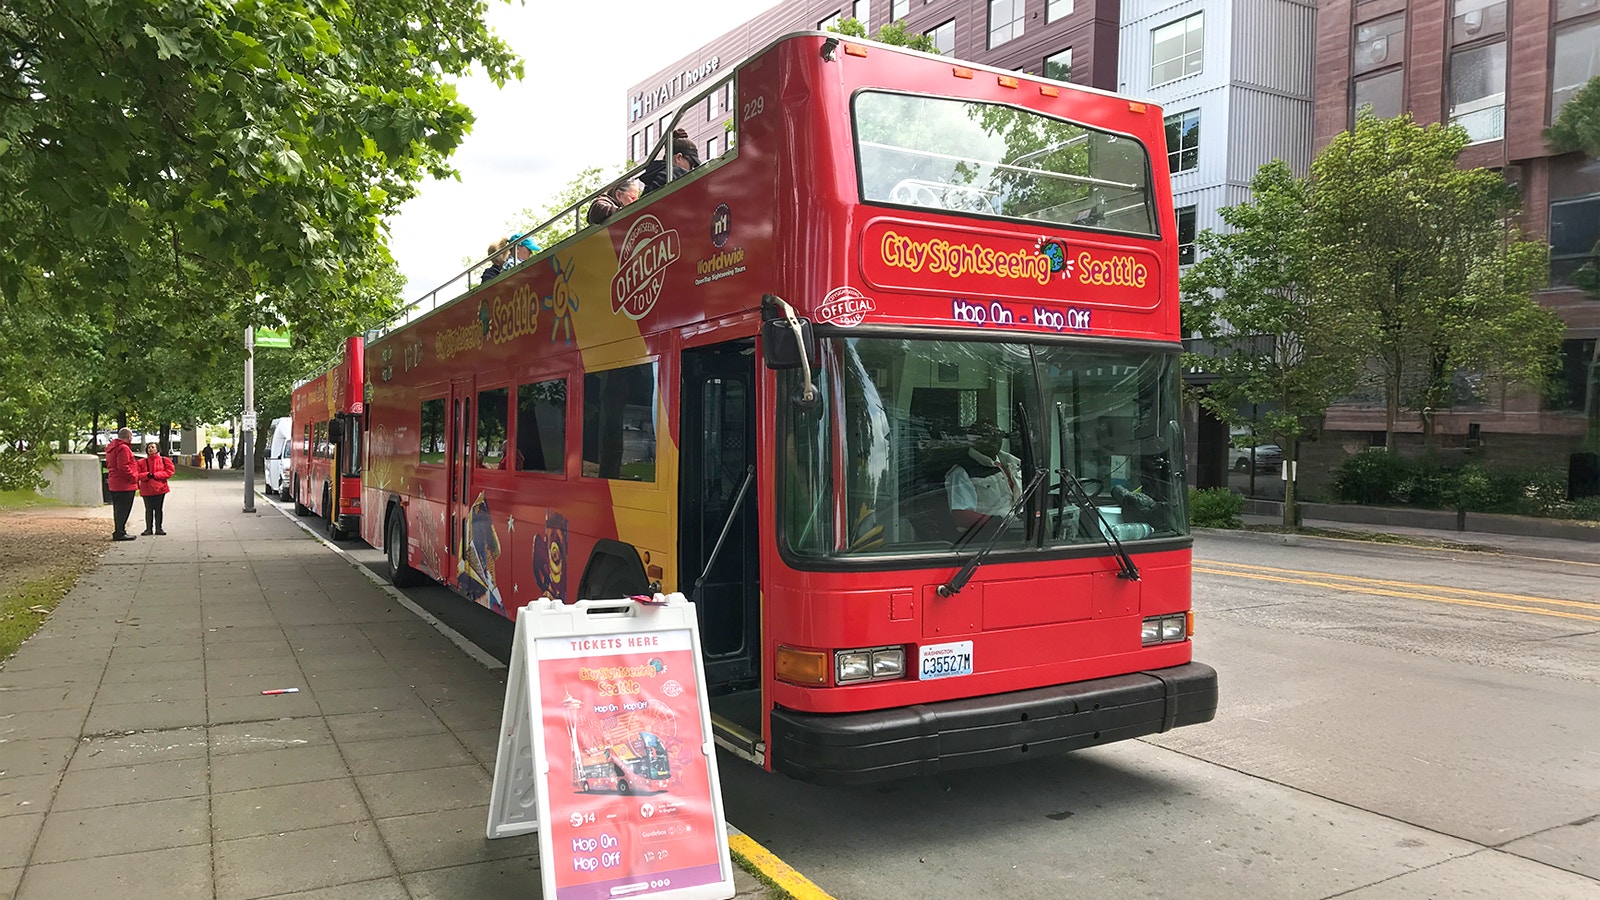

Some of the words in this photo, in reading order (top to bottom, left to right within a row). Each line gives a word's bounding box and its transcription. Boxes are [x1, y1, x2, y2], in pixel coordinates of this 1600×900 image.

[644, 70, 687, 114] HYATT
[686, 55, 720, 88] house
[743, 96, 764, 122] 229
[616, 235, 676, 303] OFFICIAL
[697, 246, 745, 274] Worldwide
[1078, 251, 1148, 288] Seattle
[633, 277, 660, 311] TOUR
[493, 283, 540, 345] Seattle
[821, 299, 873, 319] OFFICIAL
[840, 313, 862, 325] TOUR
[952, 299, 987, 326] Hop
[989, 300, 1015, 325] On
[1033, 307, 1065, 331] Hop
[1066, 307, 1091, 330] Off
[571, 638, 622, 651] TICKETS
[628, 636, 659, 647] HERE
[923, 649, 954, 657] WASHINGTON
[923, 653, 971, 675] C35527M
[598, 680, 641, 697] Seattle
[594, 705, 608, 713] Hop
[608, 703, 619, 712] On
[623, 703, 636, 711] Hop
[637, 701, 649, 709] Off
[583, 812, 596, 824] 14
[572, 838, 598, 852] Hop
[600, 833, 618, 848] On
[573, 857, 599, 871] Hop
[601, 852, 621, 868] Off
